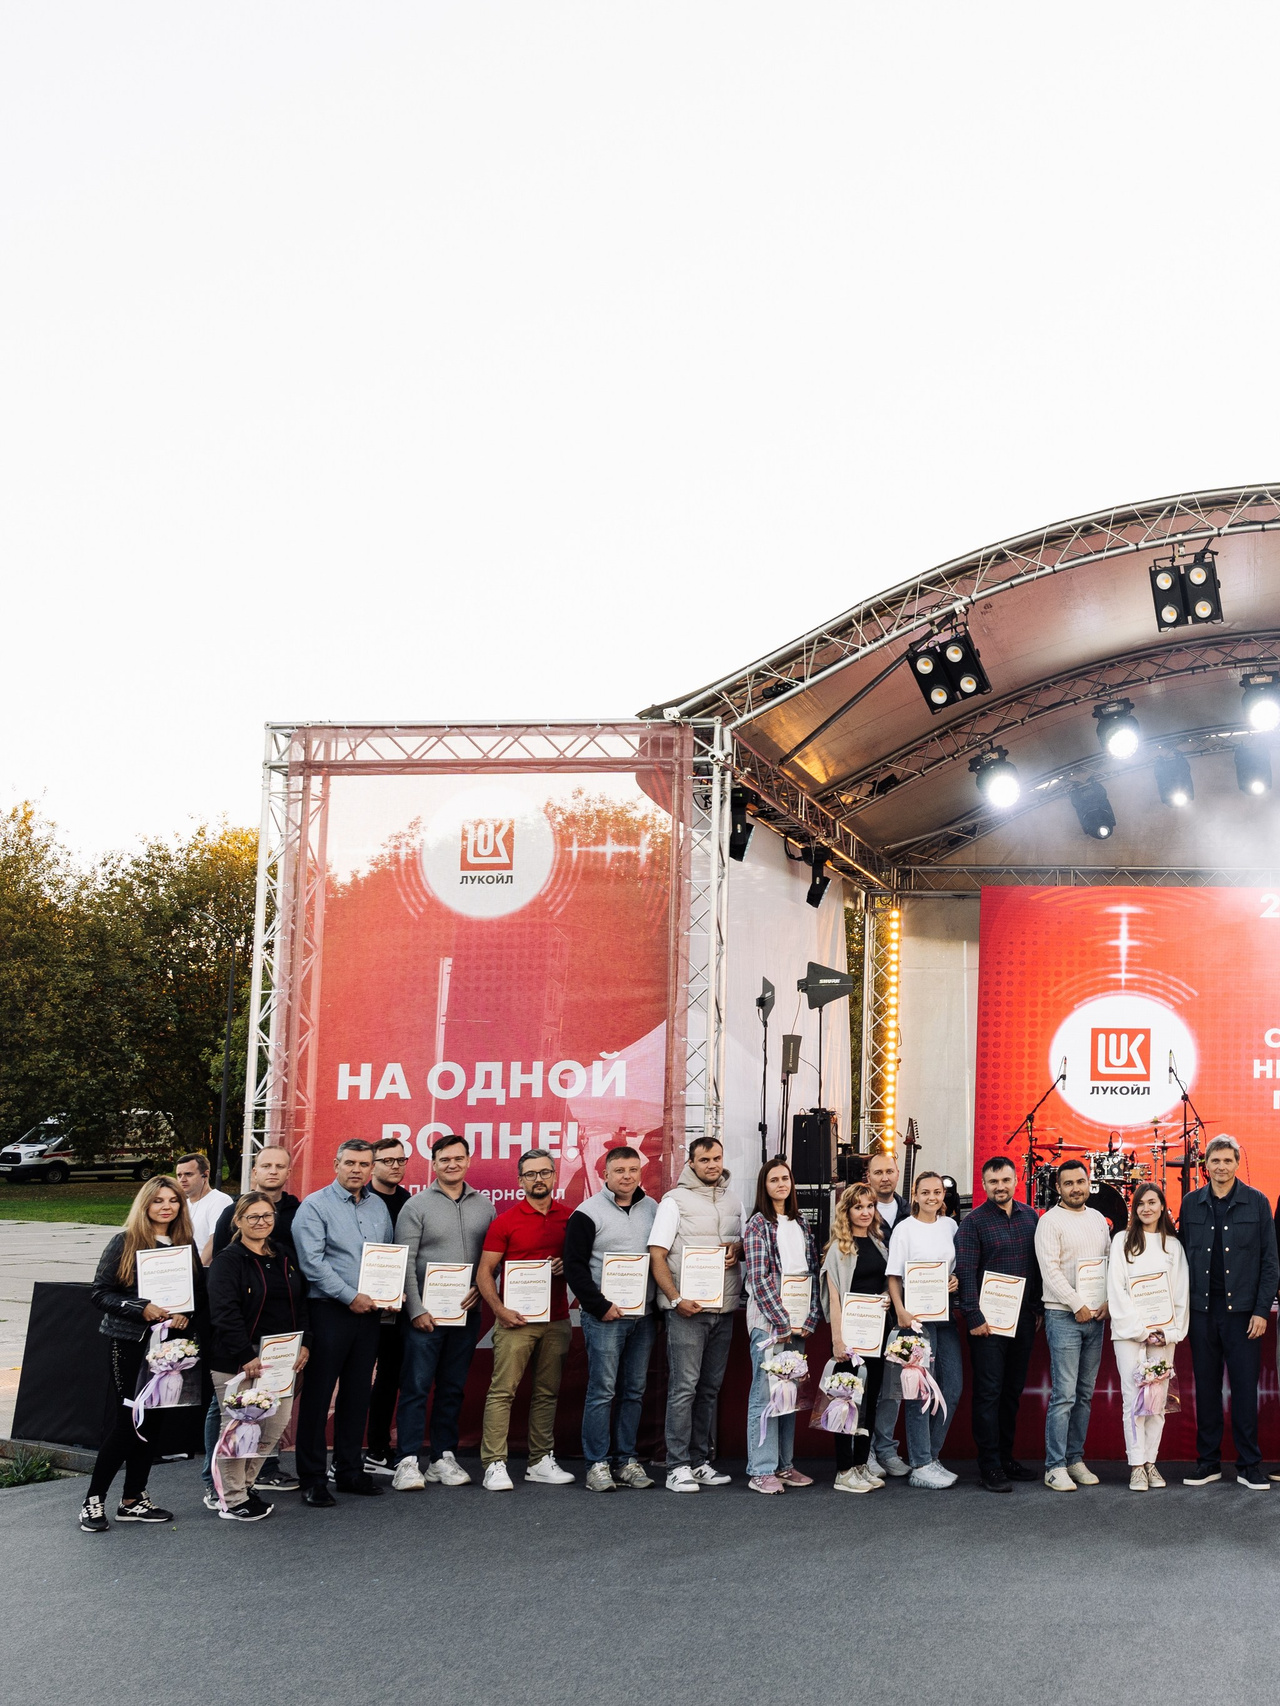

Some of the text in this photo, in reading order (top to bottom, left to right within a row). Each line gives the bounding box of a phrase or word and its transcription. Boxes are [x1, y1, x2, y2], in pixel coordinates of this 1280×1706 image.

[460, 873, 514, 885] ЛУКОЙЛ
[337, 1051, 627, 1106] НА ОДНОЙ
[1090, 1084, 1151, 1096] ЛУКОЙЛ
